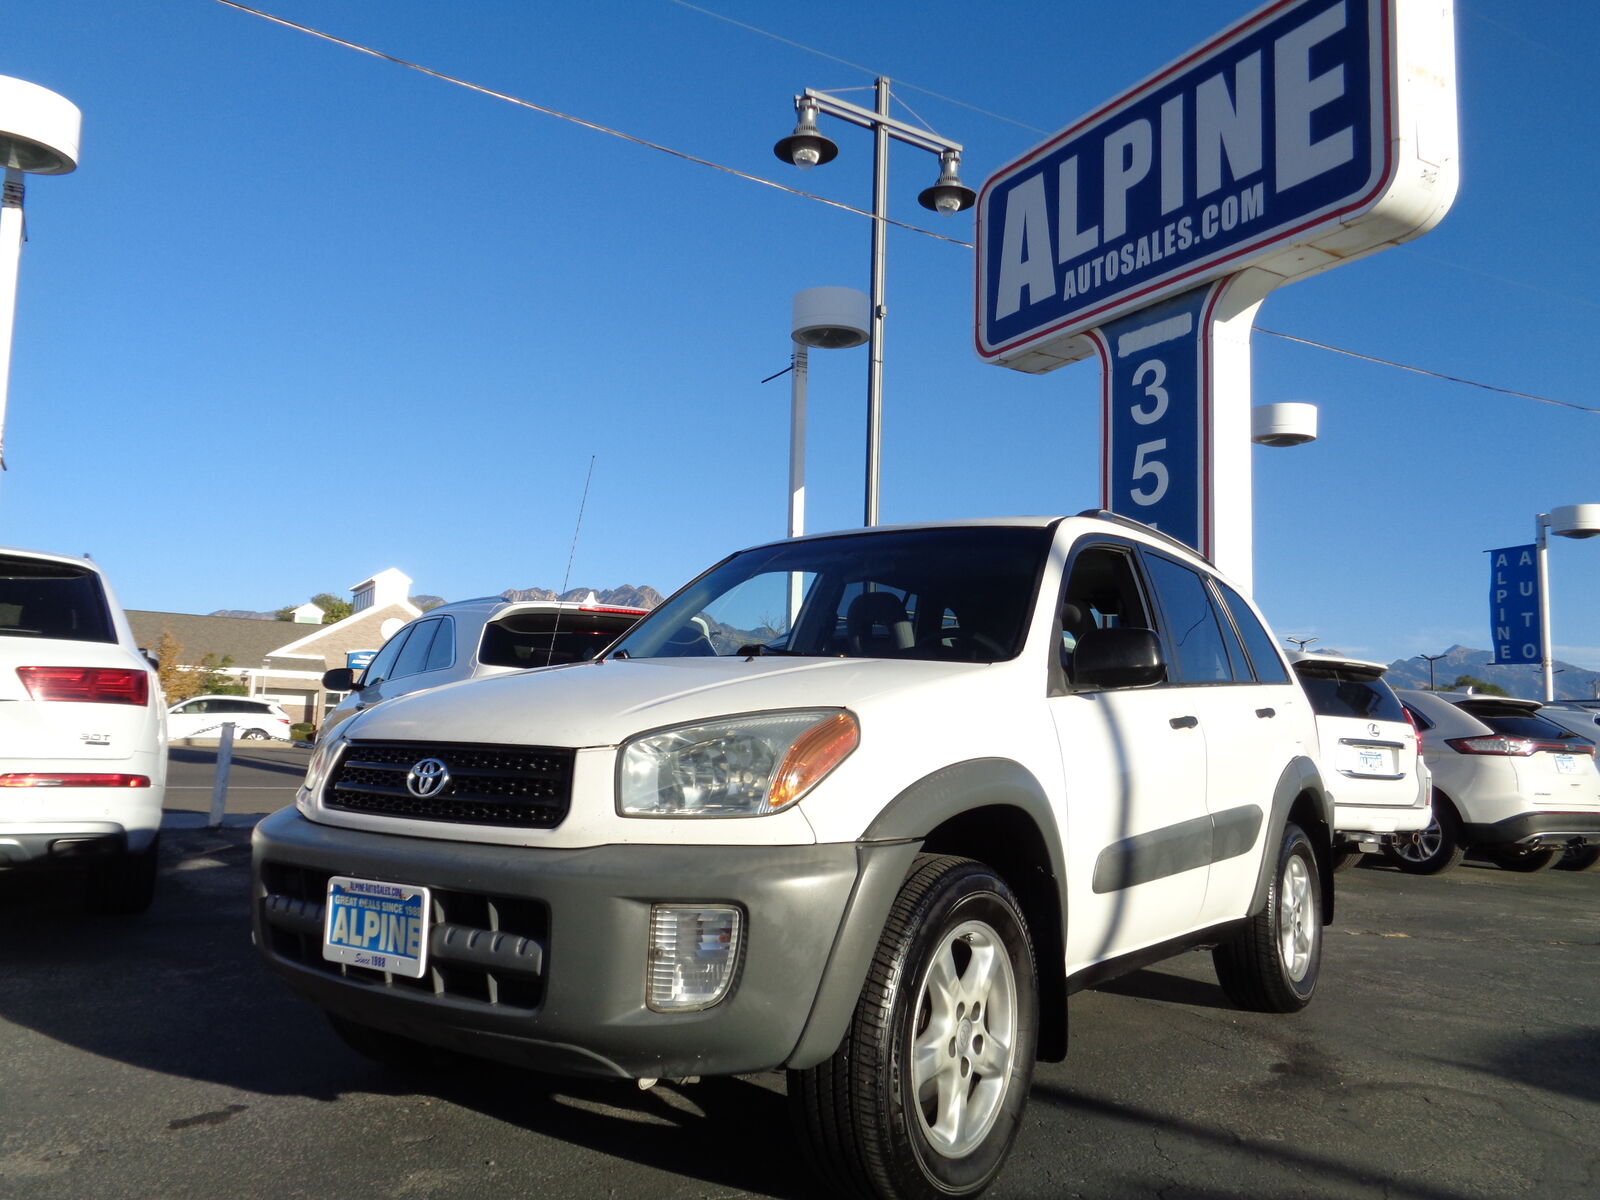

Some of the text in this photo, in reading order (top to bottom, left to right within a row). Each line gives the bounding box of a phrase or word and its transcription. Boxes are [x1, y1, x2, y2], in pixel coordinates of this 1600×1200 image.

[995, 0, 1354, 322] ALPINE
[1063, 181, 1265, 301] AUTOSALES.COM
[1496, 553, 1511, 659] ALPINE
[1519, 551, 1537, 659] AUTO
[332, 906, 420, 955] ALPINE
[335, 895, 358, 906] GREAT
[382, 902, 404, 913] SINCE
